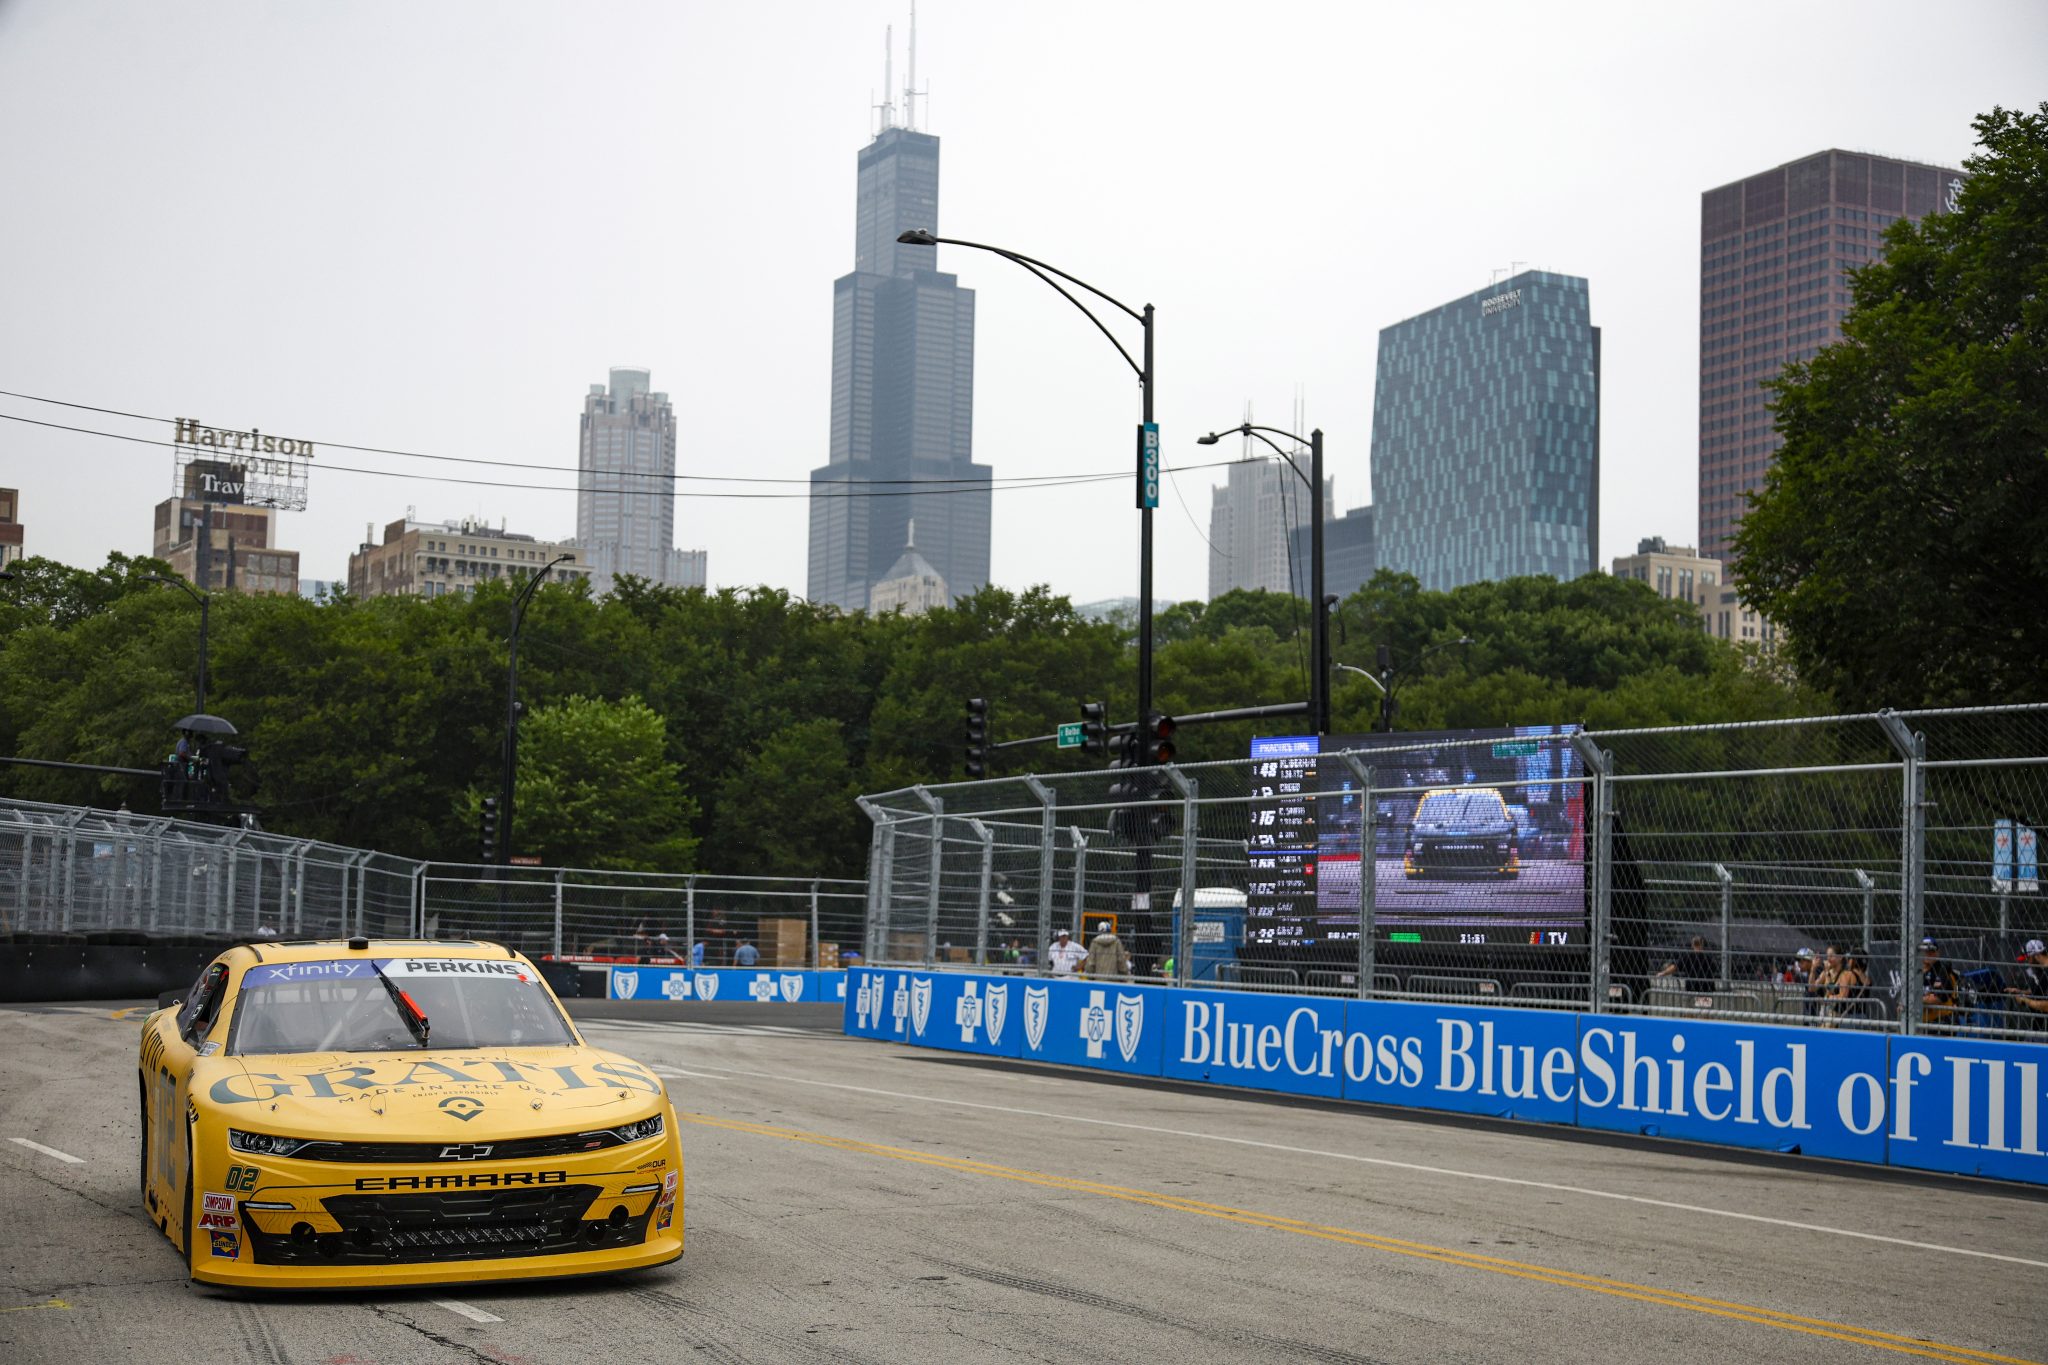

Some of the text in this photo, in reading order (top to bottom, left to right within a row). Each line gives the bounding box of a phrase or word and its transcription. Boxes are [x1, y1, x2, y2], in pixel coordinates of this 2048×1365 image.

[175, 417, 314, 458] Harrison
[1145, 431, 1158, 499] B300
[1548, 932, 1567, 945] TV
[268, 961, 360, 981] xfinity
[405, 962, 520, 975] PERKINS
[209, 1061, 662, 1105] GRATIS
[1179, 1000, 2048, 1157] BlueCross BlueShield of Ill
[339, 1087, 405, 1104] MADE
[518, 1084, 563, 1096] USA
[652, 1159, 666, 1168] OUR
[224, 1164, 261, 1193] 02
[355, 1170, 567, 1191] CAMARO
[204, 1194, 233, 1211] SIMPSON
[199, 1213, 237, 1228] ARP
[212, 1239, 238, 1250] SUNOCO
